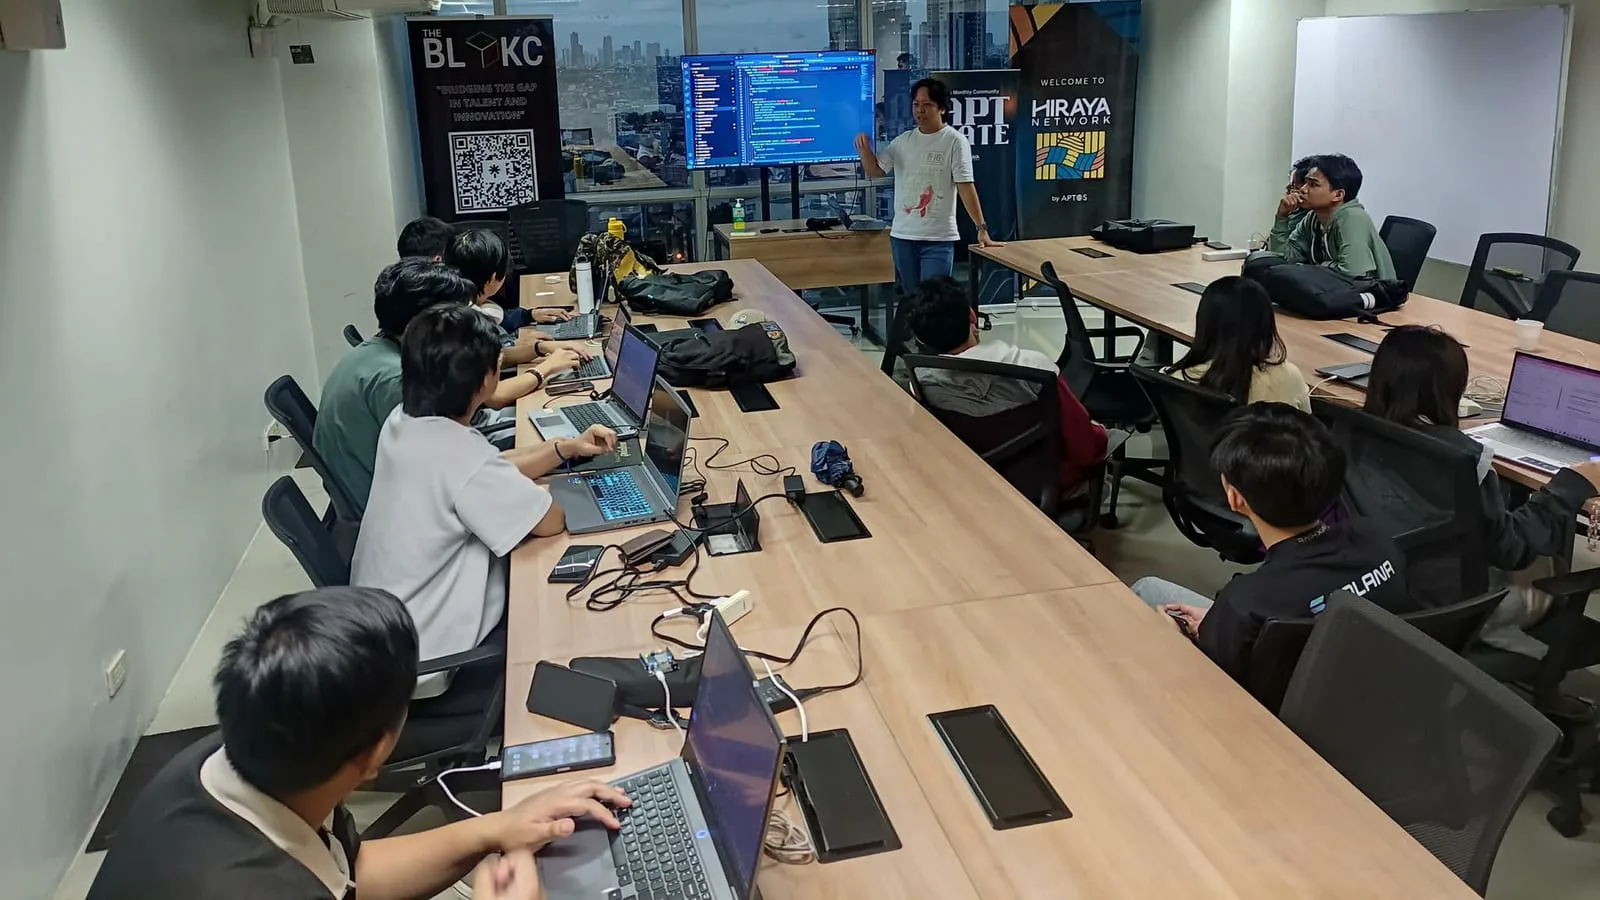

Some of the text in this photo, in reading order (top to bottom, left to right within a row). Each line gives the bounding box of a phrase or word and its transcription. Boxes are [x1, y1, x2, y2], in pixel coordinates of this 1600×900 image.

[422, 29, 442, 37] THE
[1041, 76, 1105, 87] WELCOME TO
[494, 83, 515, 93] THE
[516, 82, 538, 93] GAP
[449, 96, 528, 108] IN TALENT AND
[1032, 97, 1112, 118] HIRAYA
[1031, 116, 1111, 127] NETWORK
[1051, 195, 1060, 203] by
[1341, 559, 1395, 597] LANA
